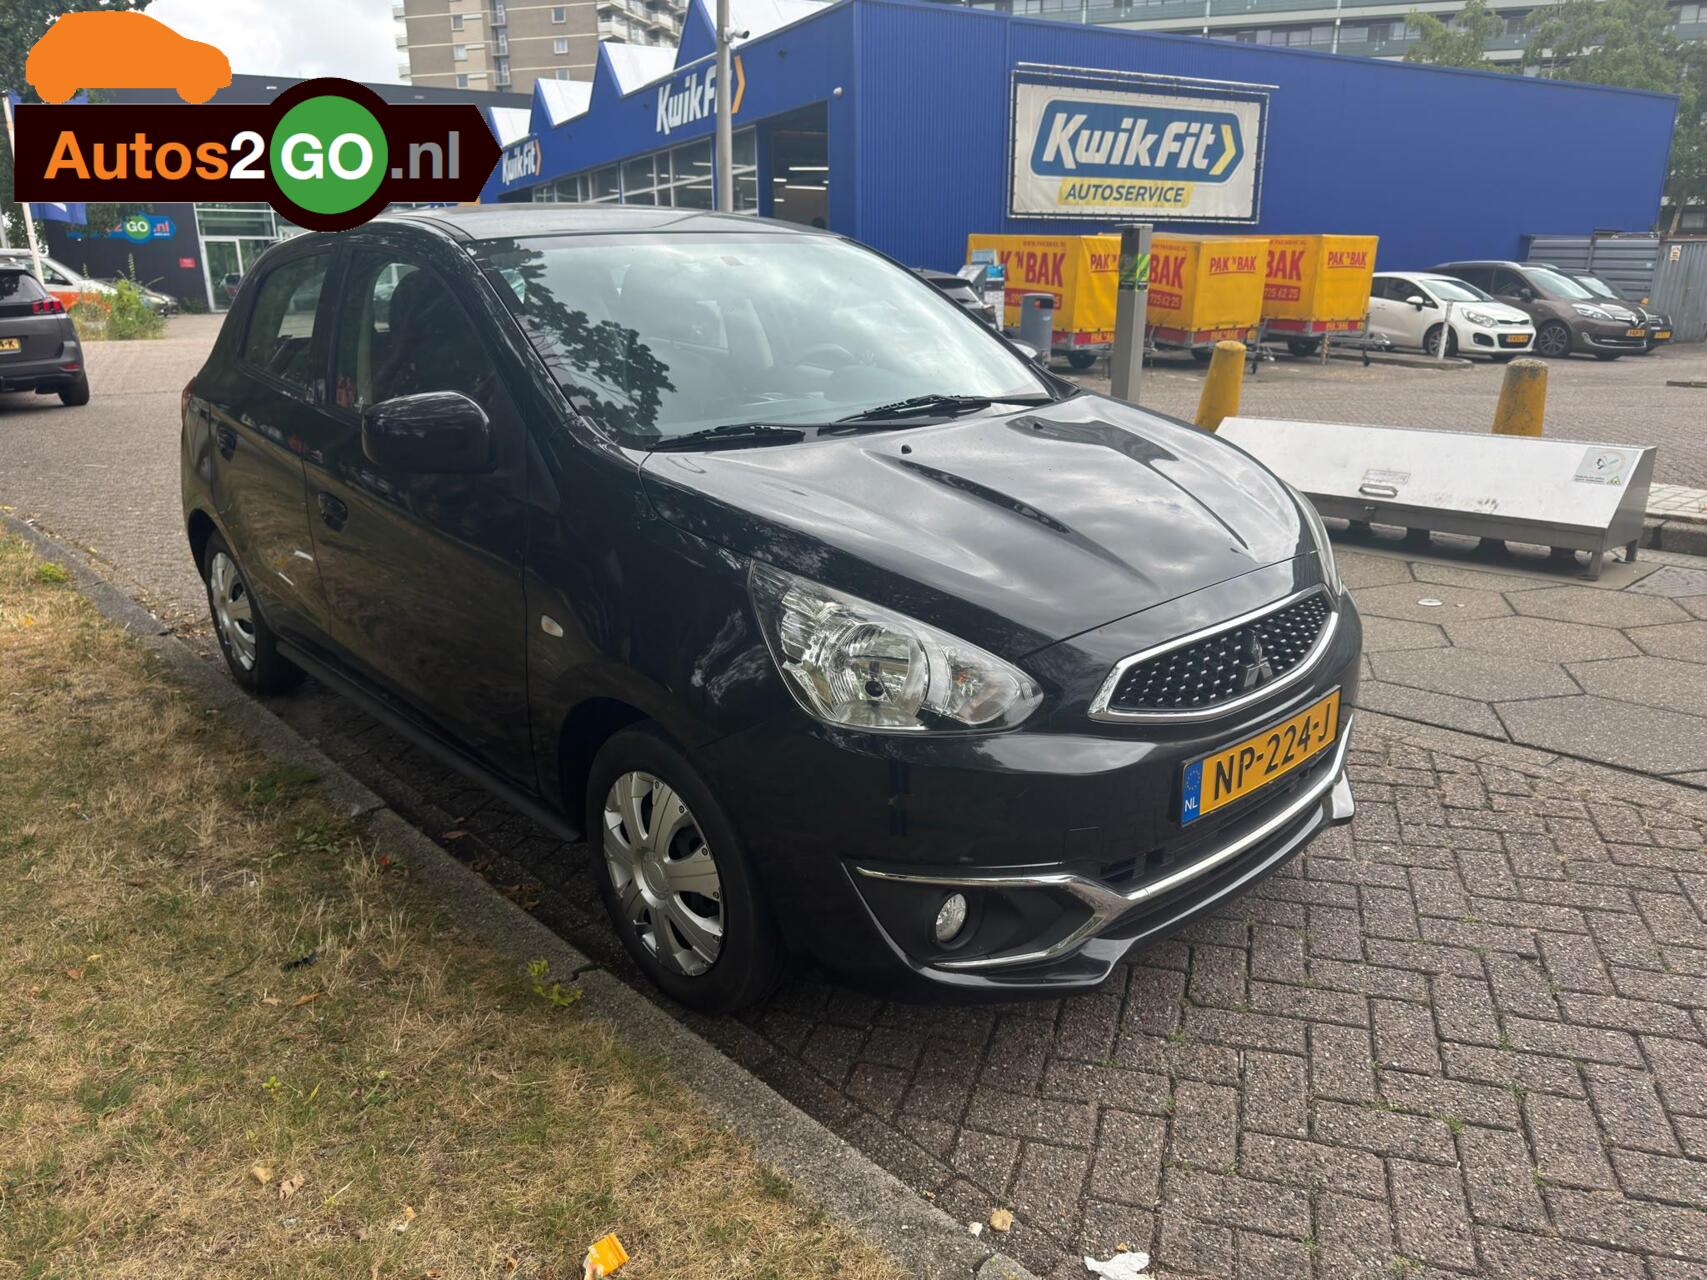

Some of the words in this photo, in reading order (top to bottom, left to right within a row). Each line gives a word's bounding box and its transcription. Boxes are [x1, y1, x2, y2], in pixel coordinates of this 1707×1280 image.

[656, 64, 733, 135] KwikF
[1065, 183, 1185, 203] AUTOSERVICE
[1025, 251, 1066, 288] BAK
[1090, 253, 1110, 270] PAK
[1210, 257, 1229, 272] PAK
[1237, 255, 1257, 271] BAK
[1265, 250, 1306, 281] BAK
[1327, 251, 1345, 266] PAK
[1349, 251, 1367, 266] BAK
[1151, 254, 1186, 289] BAK
[1213, 702, 1332, 801] NP-224-J
[1184, 797, 1199, 813] NL
